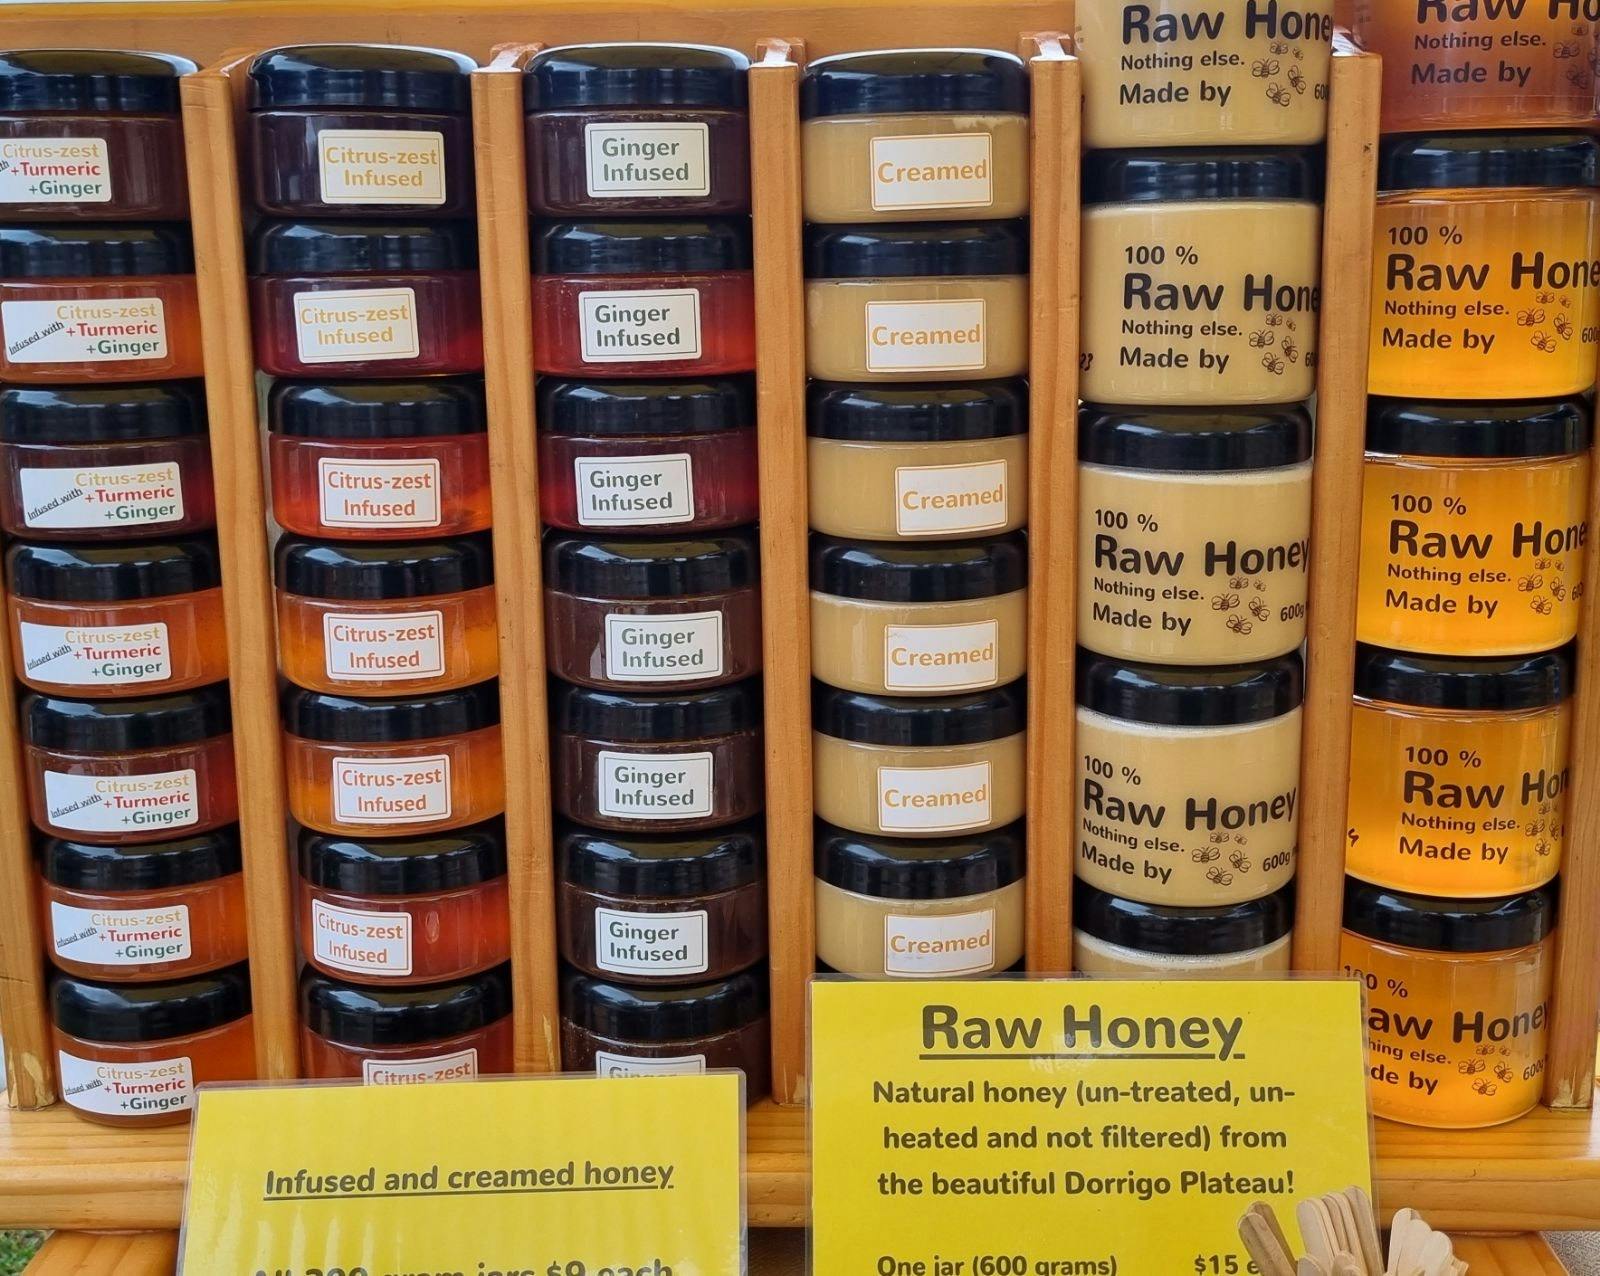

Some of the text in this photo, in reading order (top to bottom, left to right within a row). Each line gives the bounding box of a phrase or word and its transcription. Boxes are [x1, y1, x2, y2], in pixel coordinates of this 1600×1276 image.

[1417, 0, 1526, 24] Raw
[1122, 4, 1225, 45] Raw
[1414, 31, 1546, 51] Nothing else.
[1121, 51, 1245, 71] Nothing else.
[1411, 61, 1531, 88] Made by
[1120, 80, 1231, 107] Made by
[3, 144, 100, 158] Citrus-zest
[326, 147, 438, 165] Citrus-zest
[602, 138, 680, 160] Ginger
[11, 161, 101, 176] +Turmeric
[344, 170, 423, 187] Infused
[603, 163, 689, 181] Infused
[878, 159, 987, 184] Creamed
[28, 180, 102, 197] +Ginger
[1388, 225, 1462, 245] 100 %
[1125, 245, 1199, 265] 100 %
[1386, 253, 1490, 291] Raw
[1123, 272, 1224, 311] Raw
[56, 303, 157, 320] Citrus-zest
[301, 304, 409, 325] Citrus-zest
[595, 305, 670, 326] Ginger
[1384, 301, 1509, 319] Nothing else.
[41, 321, 64, 337] with
[66, 321, 158, 337] +Turmeric
[318, 327, 393, 345] Infused
[596, 327, 680, 347] Infused
[872, 324, 980, 346] Creamed
[1122, 319, 1243, 339] Nothing else.
[86, 340, 160, 356] +Ginger
[1382, 327, 1495, 354] Made by
[1120, 346, 1188, 368] Made
[1199, 348, 1229, 375] by
[75, 468, 174, 487] Citrus-zest
[328, 471, 432, 489] Citrus-zest
[590, 470, 662, 491] Ginger
[60, 488, 83, 504] with
[84, 486, 175, 503] +Turmeric
[592, 492, 672, 511] Infused
[902, 483, 1003, 510] Creamed
[1391, 494, 1467, 515] 100 %
[104, 504, 176, 520] +Ginger
[344, 500, 415, 517] Infused
[1095, 509, 1158, 533] 100 %
[1390, 519, 1493, 559] Raw
[1094, 533, 1310, 577] Raw Honey
[1388, 563, 1511, 585] Nothing else.
[1094, 576, 1204, 601] Nothing else.
[1385, 588, 1498, 619] Made by
[1093, 602, 1192, 636] Made by
[65, 627, 160, 643] Citrus-zest
[333, 624, 435, 642] Citrus-zest
[621, 628, 695, 649] Ginger
[52, 644, 72, 658] with
[73, 645, 162, 660] +Turmeric
[350, 651, 420, 668] Infused
[622, 649, 704, 667] Infused
[891, 642, 993, 666] Creamed
[92, 661, 162, 677] +Ginger
[1406, 746, 1482, 768] 100 %
[342, 768, 442, 787] Citrus-zest
[614, 766, 686, 788] Ginger
[1084, 755, 1141, 786] 100 %
[95, 775, 190, 793] Citrus-zest
[1403, 770, 1504, 809] Raw
[81, 794, 102, 807] with
[103, 791, 190, 809] +Turmeric
[358, 795, 426, 812] Infused
[615, 788, 694, 806] Infused
[884, 784, 987, 808] Creamed
[1083, 778, 1296, 830] Raw Honey
[121, 808, 191, 824] +Ginger
[1401, 811, 1520, 834] Nothing else.
[1082, 818, 1185, 853] Nothing else.
[1400, 836, 1508, 865] Made by
[1082, 840, 1172, 885] Made by
[1262, 850, 1291, 873] 600g
[91, 910, 182, 927] Citrus-zest
[319, 913, 404, 939] Citrus-zest
[80, 926, 97, 938] with
[99, 927, 182, 942] +Turmeric
[609, 921, 679, 943] Ginger
[890, 929, 990, 954] Creamed
[115, 942, 183, 958] +Ginger
[329, 940, 387, 963] Infused
[610, 942, 688, 961] Infused
[1387, 978, 1408, 998] %
[922, 1004, 1243, 1061] Raw Honey
[1410, 1049, 1451, 1064] else.
[96, 1062, 184, 1079] Citrus-zest
[373, 1062, 471, 1085] Citrus-zest
[85, 1078, 103, 1090] with
[104, 1078, 186, 1094] +Turmeric
[1409, 1071, 1438, 1096] by
[120, 1094, 187, 1110] +Ginger
[873, 1080, 1296, 1108] Natural honey (un-treated, un-
[883, 1124, 1287, 1152] heated and not filtered) from
[265, 1160, 674, 1195] Infused and creamed honey
[877, 1170, 1295, 1201] the beautiful Dorrigo Plateau!
[877, 1254, 1118, 1276] One jar (600 grams)
[1194, 1254, 1239, 1276] $15
